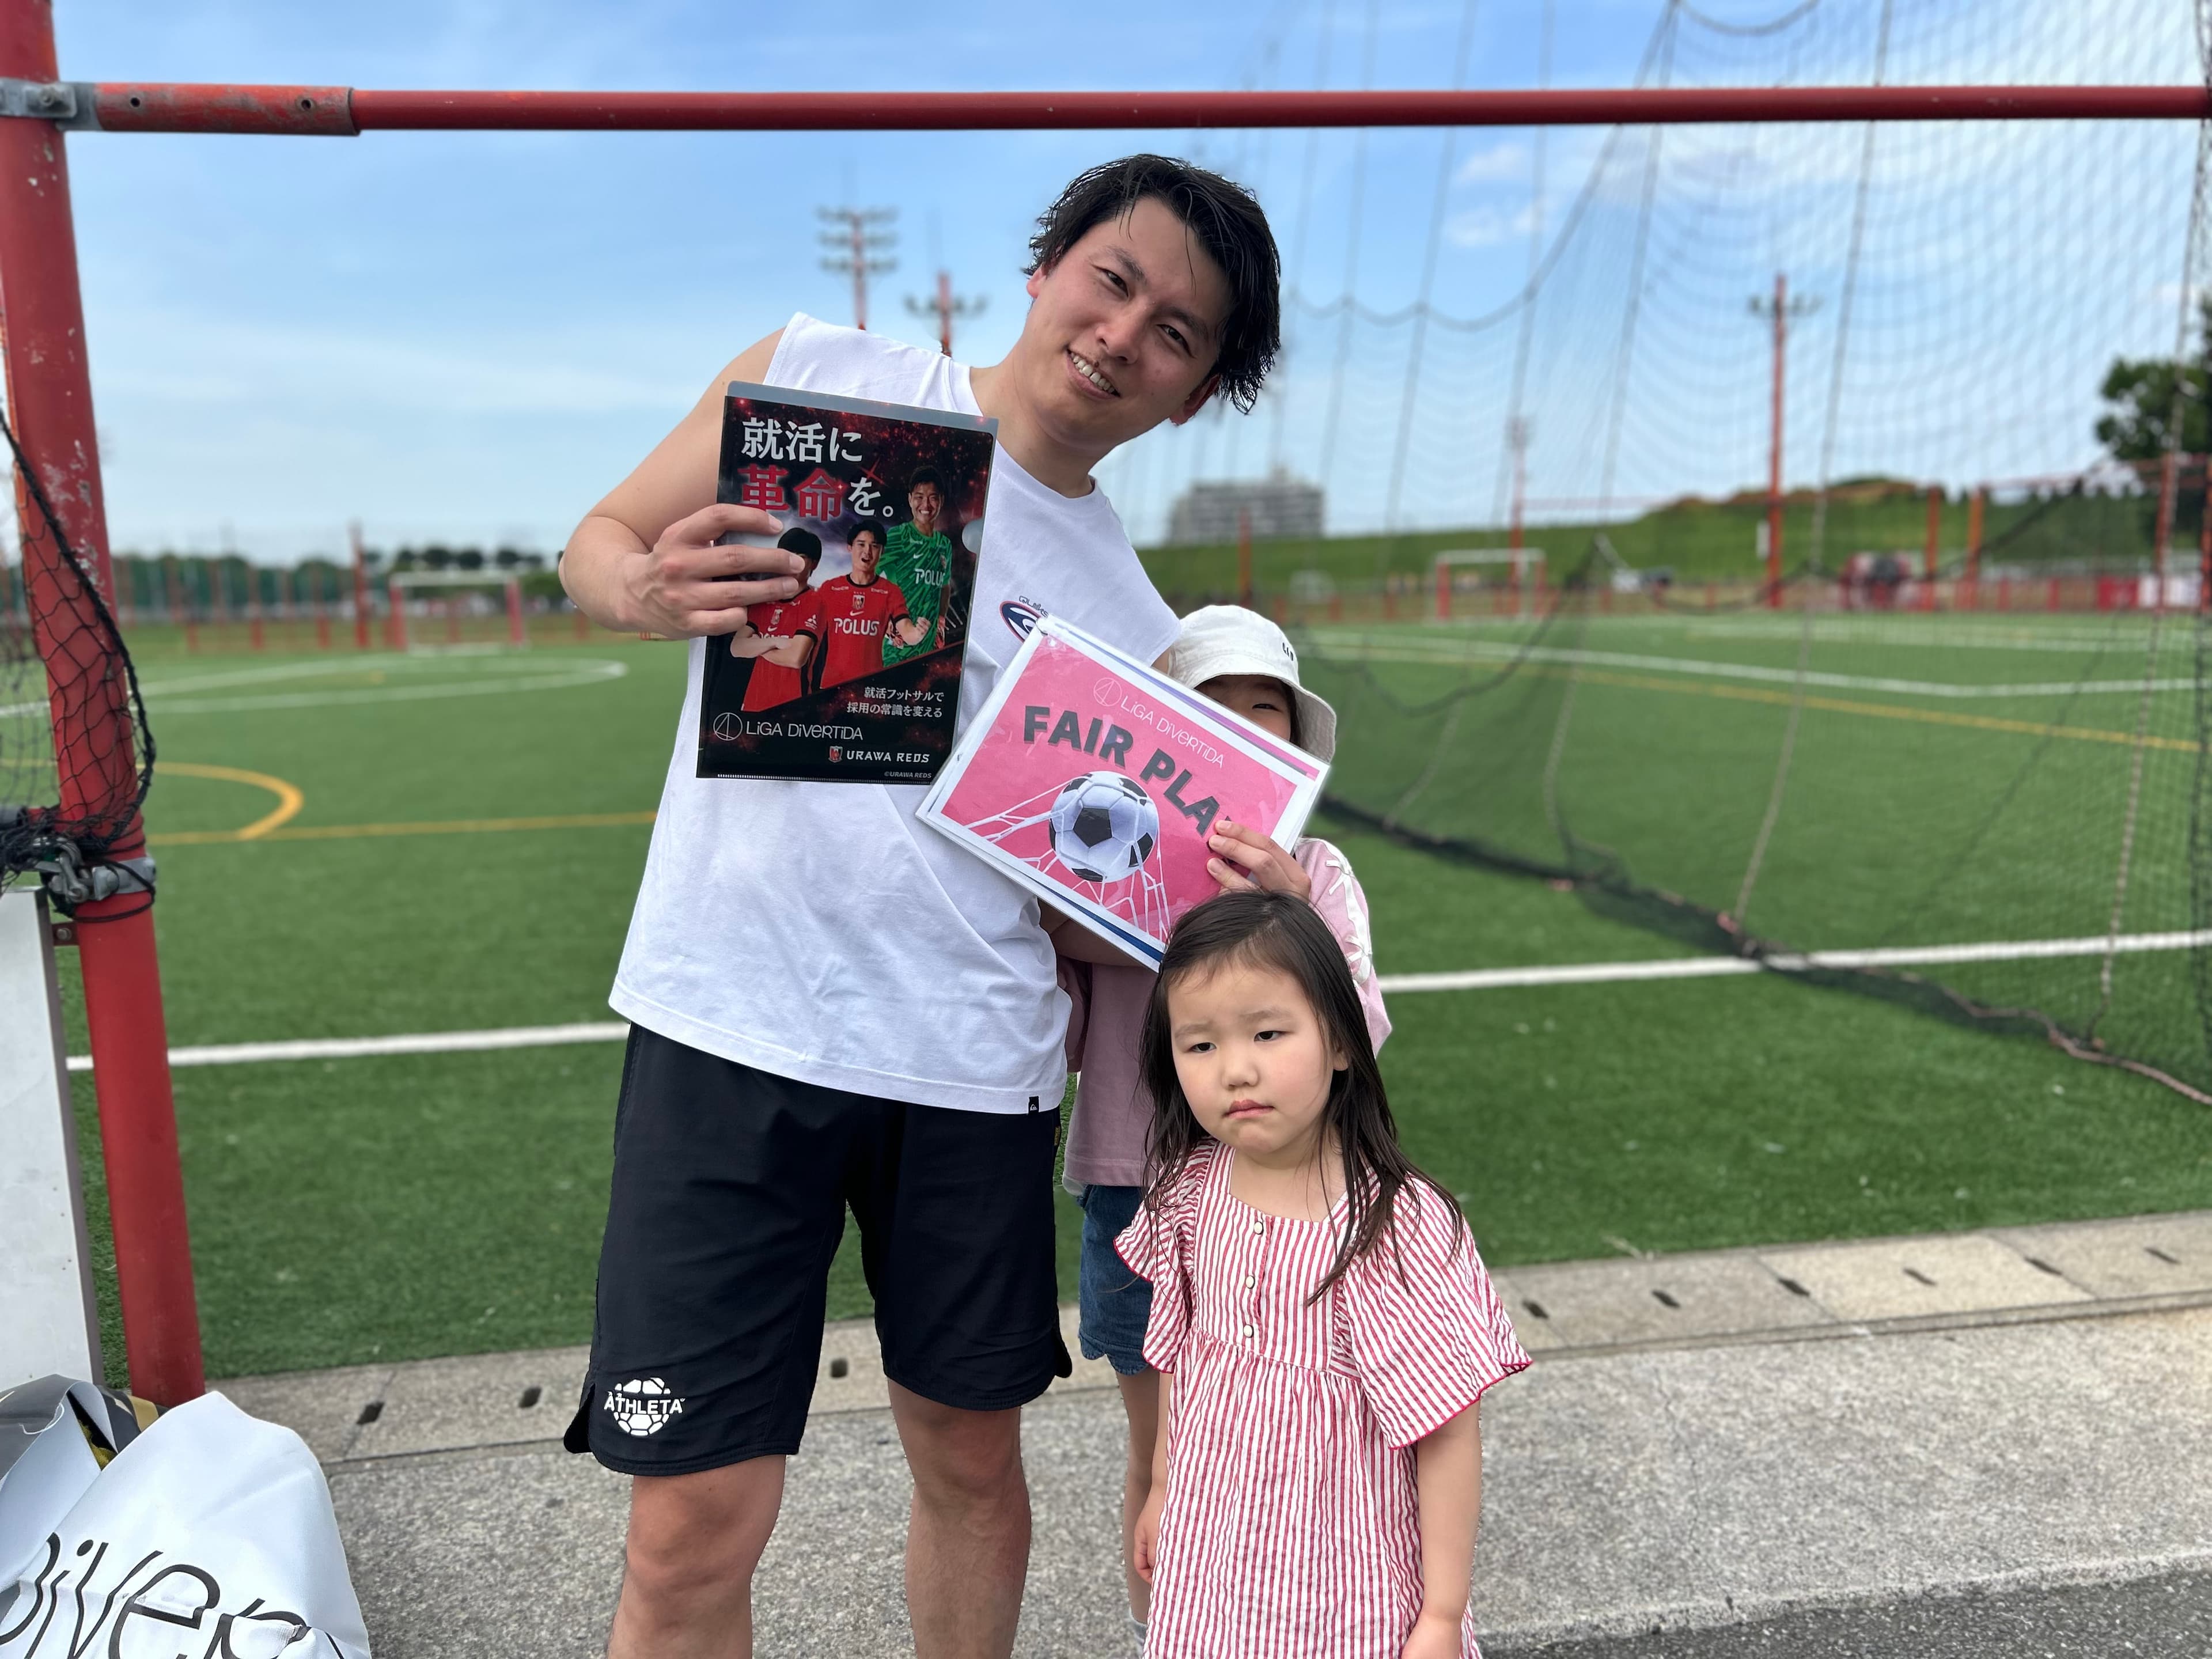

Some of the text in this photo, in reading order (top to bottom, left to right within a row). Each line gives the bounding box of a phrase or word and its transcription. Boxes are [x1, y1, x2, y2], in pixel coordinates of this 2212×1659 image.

[741, 417, 862, 463] 就活に
[737, 463, 893, 521] 革命を。
[834, 618, 880, 636] POLUS
[864, 686, 944, 702] 就活フットサルで
[846, 701, 942, 718] 採用の常識を変える
[846, 750, 930, 763] URAWA REDS
[1024, 706, 1231, 838] FAIR PLA
[604, 1392, 683, 1414] ATHLETA
